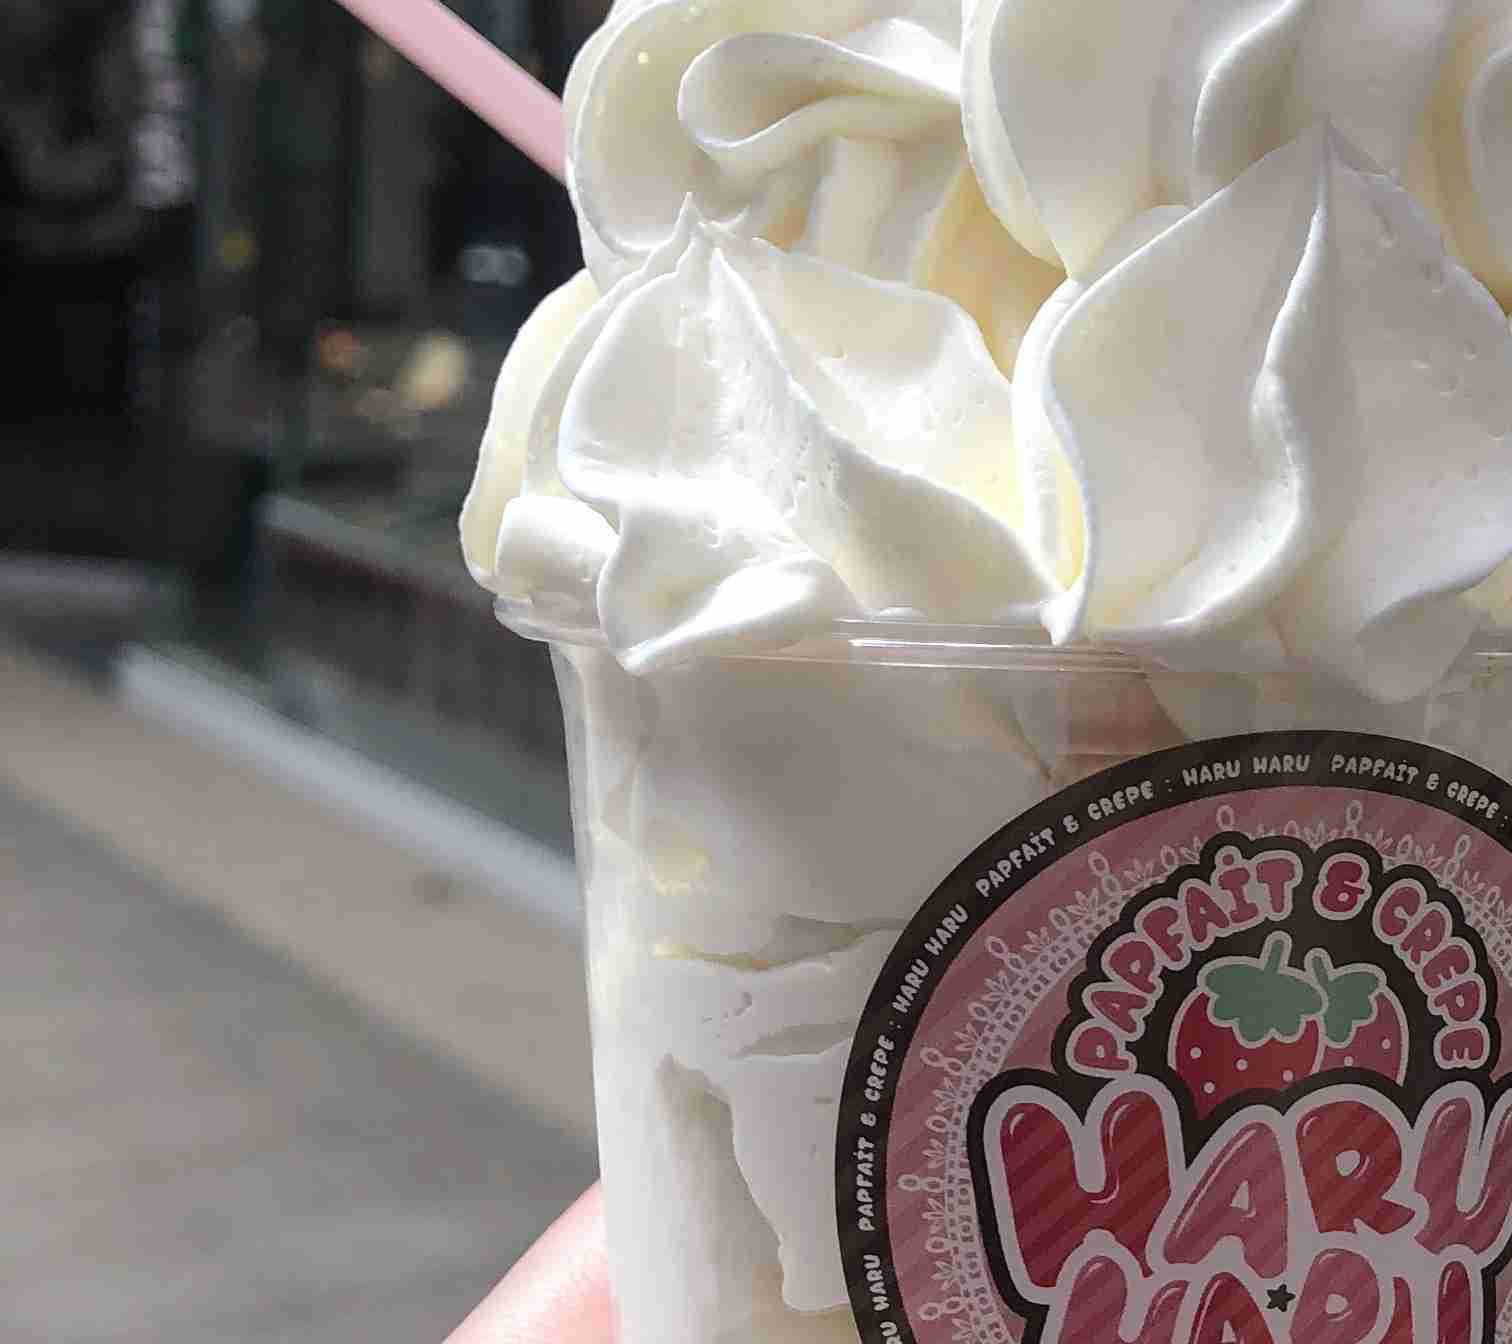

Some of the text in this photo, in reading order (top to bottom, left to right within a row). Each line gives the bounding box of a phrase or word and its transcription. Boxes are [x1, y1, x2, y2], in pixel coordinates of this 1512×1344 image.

[1183, 759, 1241, 787] HARU
[1252, 754, 1310, 774] HARU
[892, 958, 930, 1013] HARU
[924, 904, 969, 956] HARU
[1314, 854, 1373, 919] &
[1374, 879, 1489, 1068] CREPE
[863, 1254, 890, 1311] HARU
